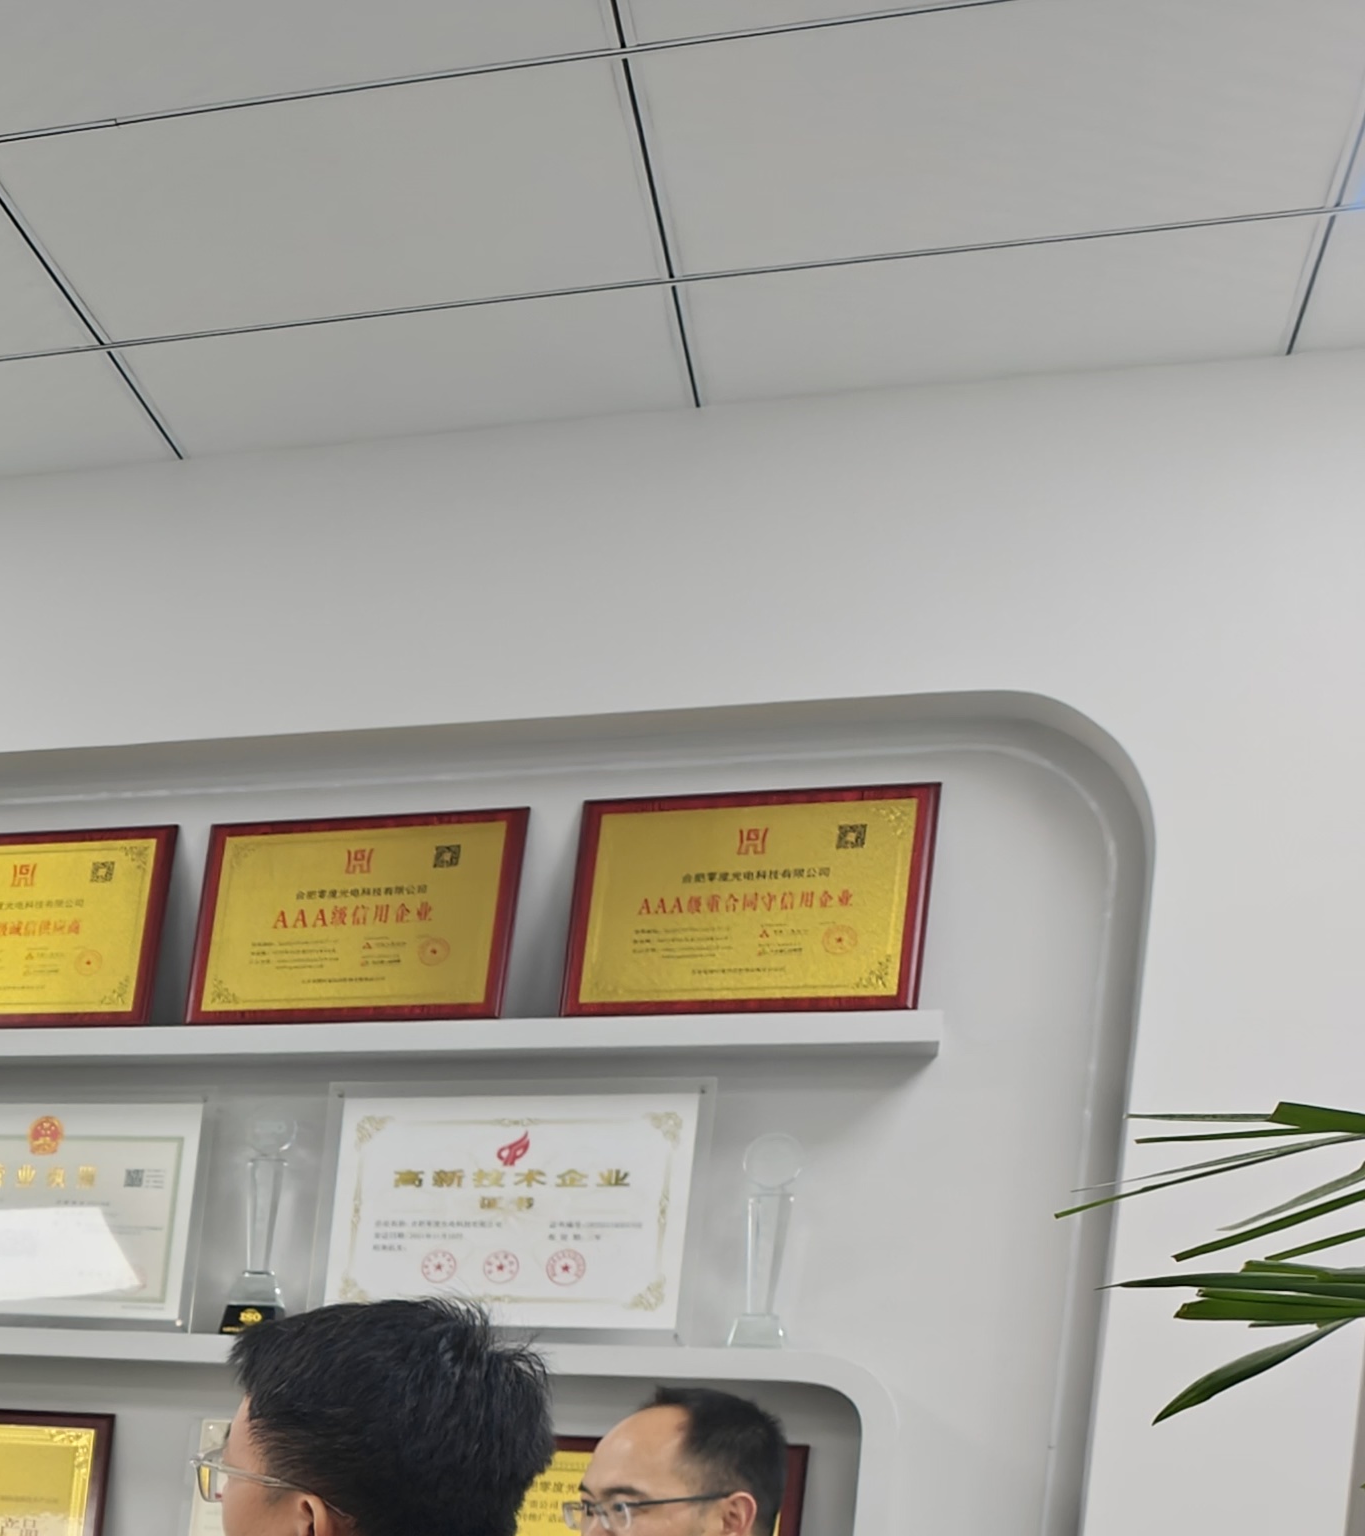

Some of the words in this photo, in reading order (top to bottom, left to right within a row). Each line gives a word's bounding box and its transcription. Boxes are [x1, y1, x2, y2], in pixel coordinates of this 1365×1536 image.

[272, 901, 434, 930] AAA级信用企业
[637, 888, 854, 916] AAA级重合同守信用企业
[392, 1167, 631, 1189] 高新技术企业
